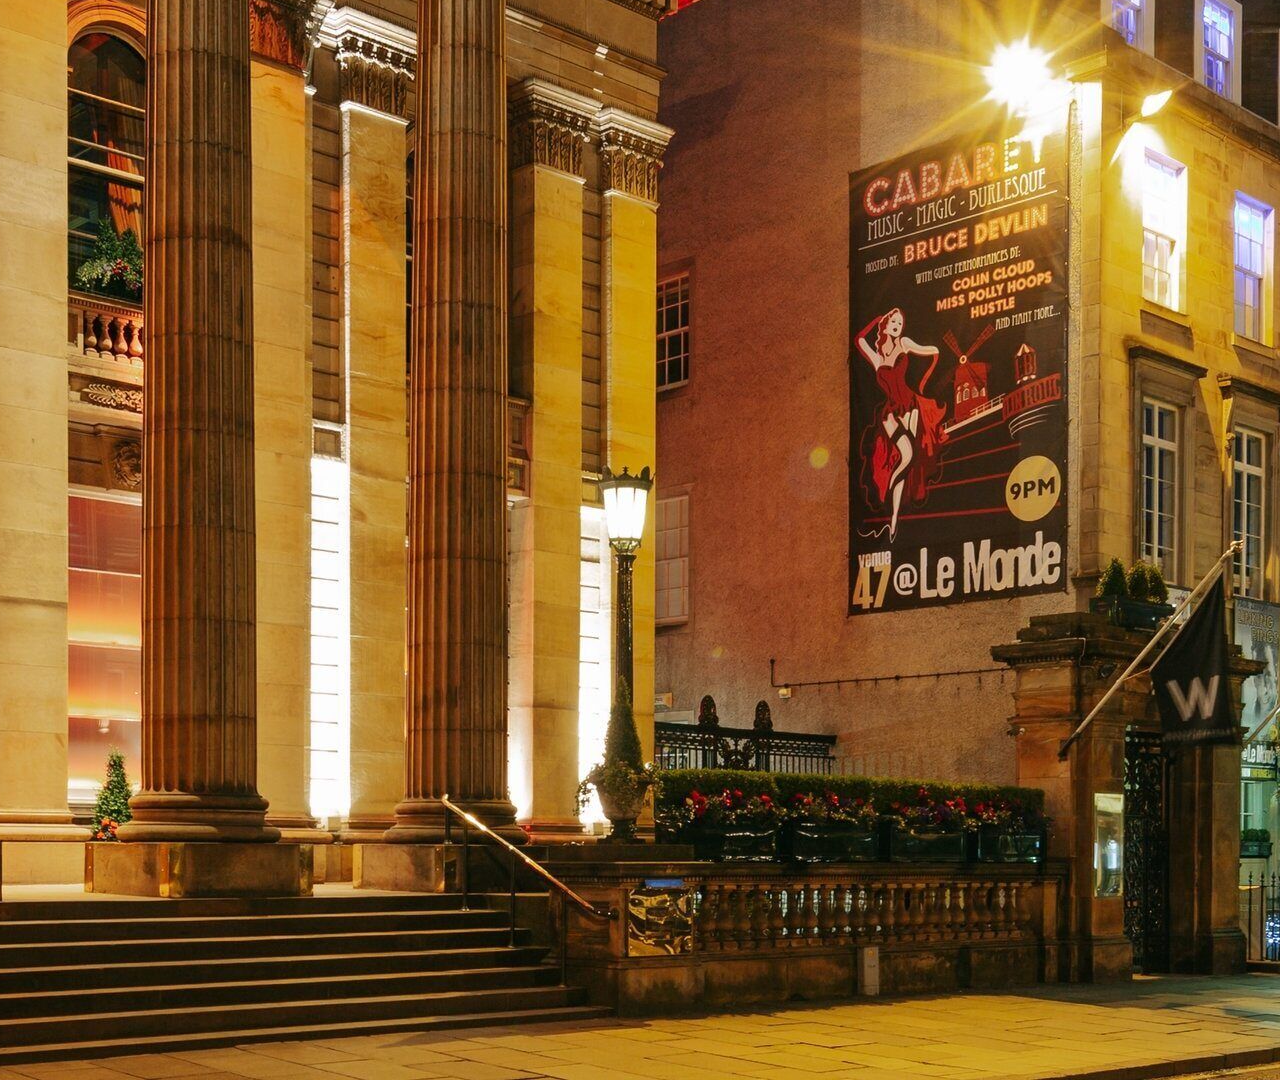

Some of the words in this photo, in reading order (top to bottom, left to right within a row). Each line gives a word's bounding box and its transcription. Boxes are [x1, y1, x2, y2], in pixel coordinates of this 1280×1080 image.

[868, 212, 904, 241] MUSIC
[916, 195, 956, 228] MAGIC
[969, 168, 1047, 211] BURLESQUE
[865, 258, 888, 274] HOSTED
[904, 228, 968, 265] BRUCE
[974, 203, 1049, 246] DEVLIN
[915, 269, 933, 285] WITH
[933, 264, 953, 279] GUEST
[952, 270, 990, 292] COLIN
[992, 259, 1035, 281] CLOUD
[936, 293, 965, 312] MISS
[968, 283, 1004, 305] POLLY
[1006, 271, 1052, 294] HOOPS
[970, 296, 1016, 319] HUSTLE
[995, 316, 1011, 330] AND
[1012, 310, 1032, 326] MANY
[1010, 476, 1056, 500] 9PM
[852, 567, 891, 609] 47
[893, 563, 918, 596] @
[920, 547, 955, 599] Le
[963, 531, 1061, 594] Monde
[858, 550, 891, 568] venue
[1167, 674, 1220, 721] W
